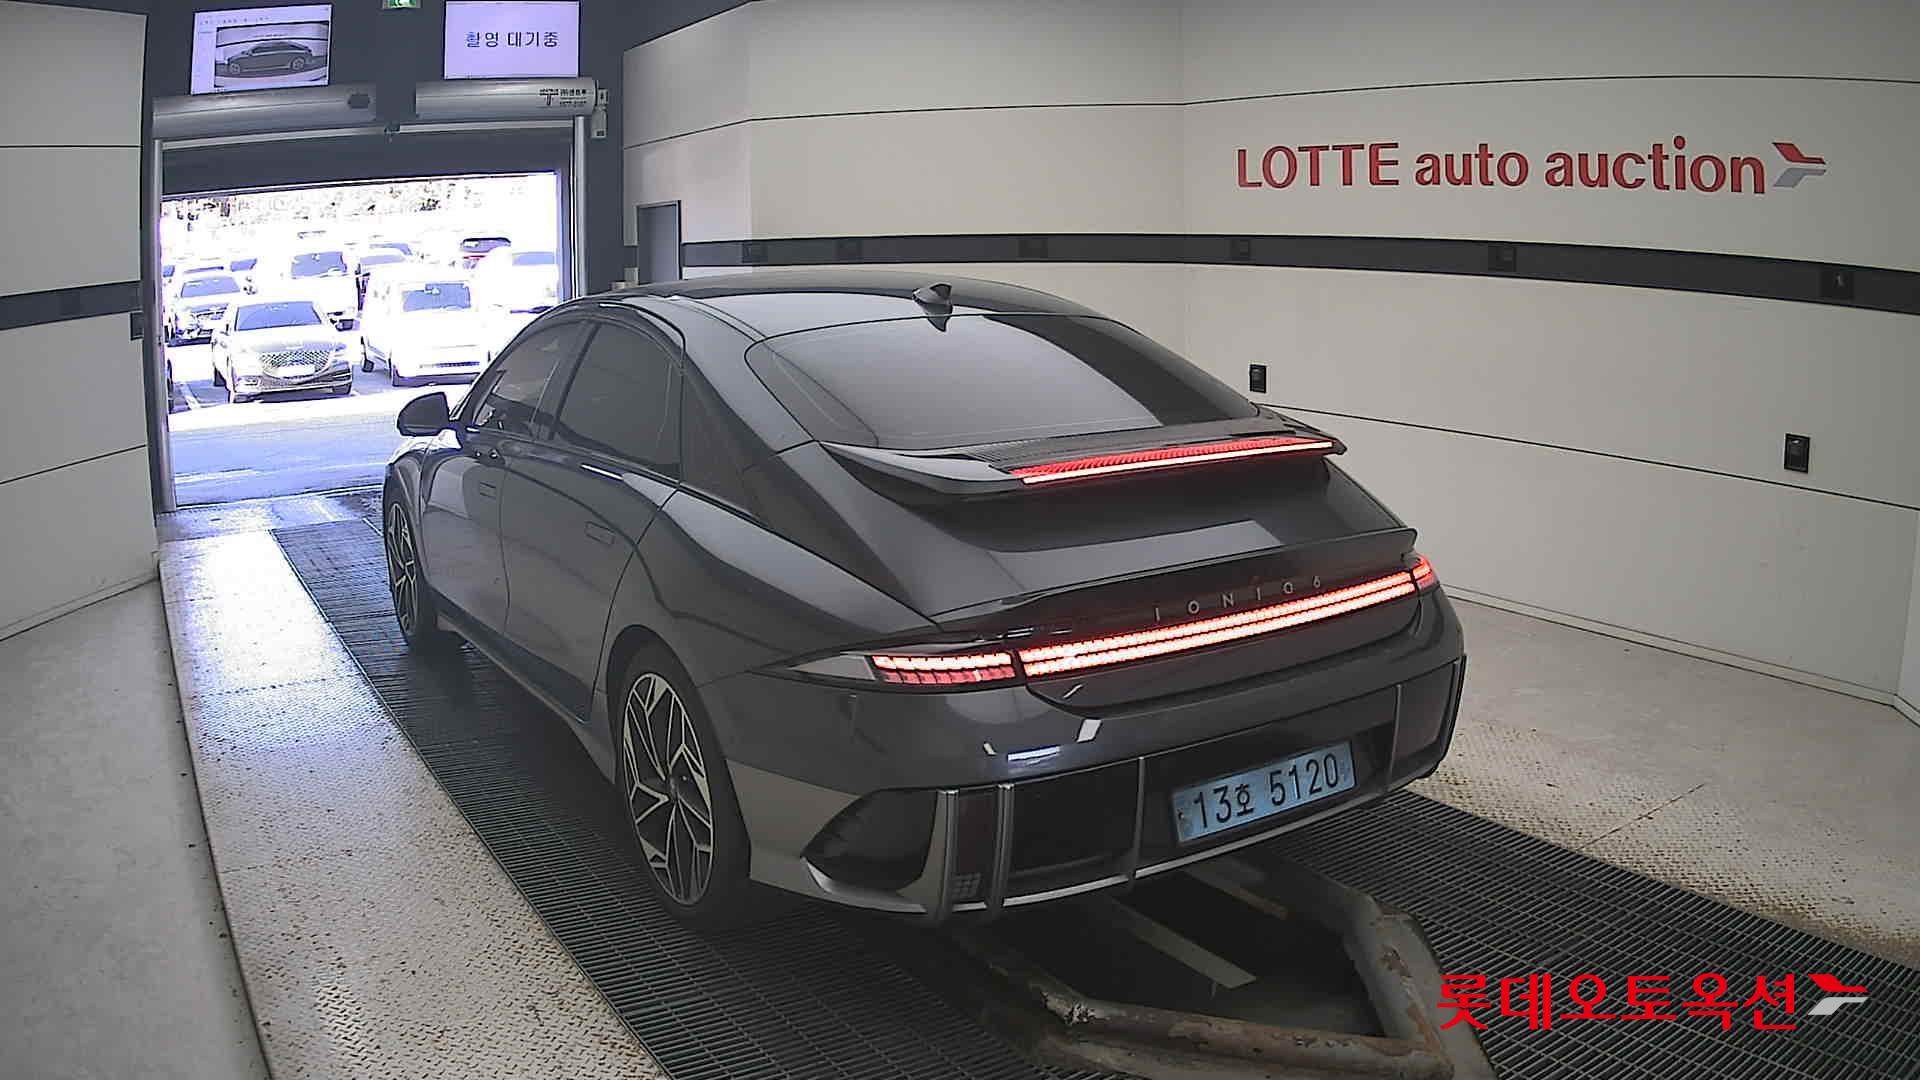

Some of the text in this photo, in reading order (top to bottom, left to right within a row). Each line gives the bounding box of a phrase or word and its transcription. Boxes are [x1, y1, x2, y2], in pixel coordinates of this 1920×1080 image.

[467, 31, 558, 48] 촬영 대기중
[1237, 135, 1766, 194] LOTTE auto auction
[1193, 753, 1339, 829] 13호 5120
